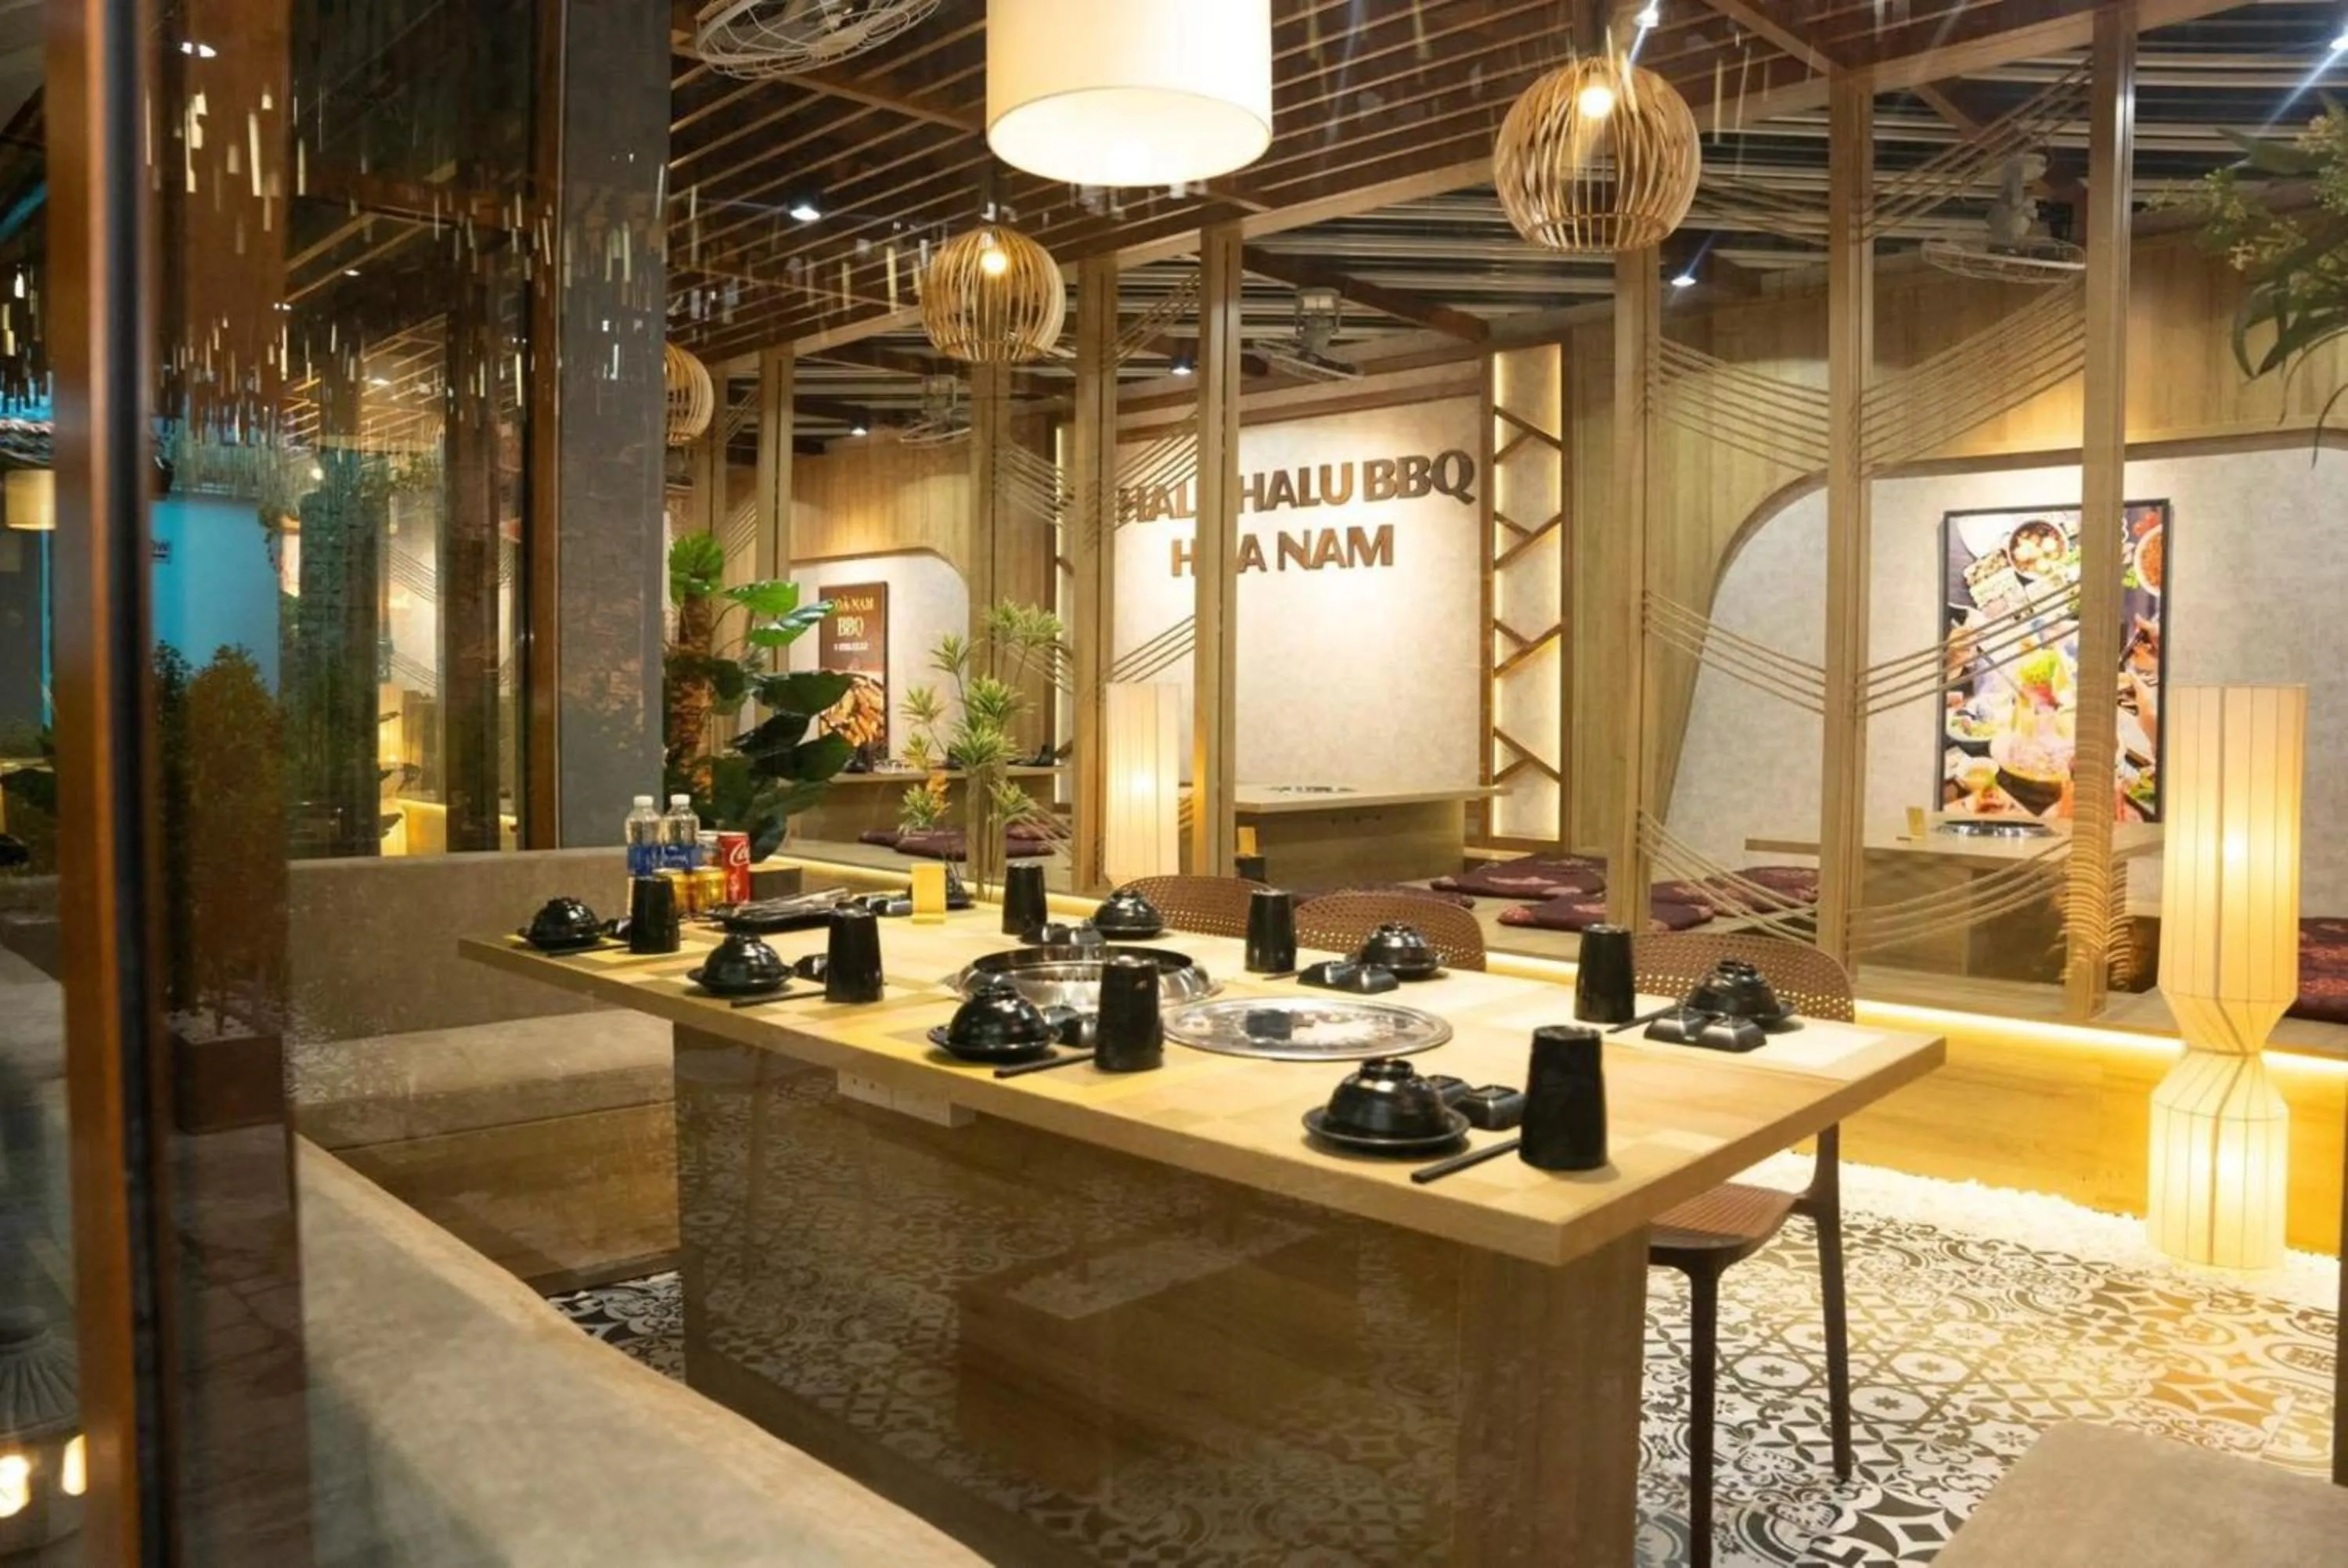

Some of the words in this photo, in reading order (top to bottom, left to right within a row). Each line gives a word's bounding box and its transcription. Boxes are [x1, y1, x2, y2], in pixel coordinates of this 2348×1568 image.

[1117, 484, 1198, 523] HAL
[1239, 462, 1353, 513] HALU
[1363, 449, 1475, 505] BBQ
[1171, 534, 1267, 577] HA
[1277, 524, 1394, 571] NAM
